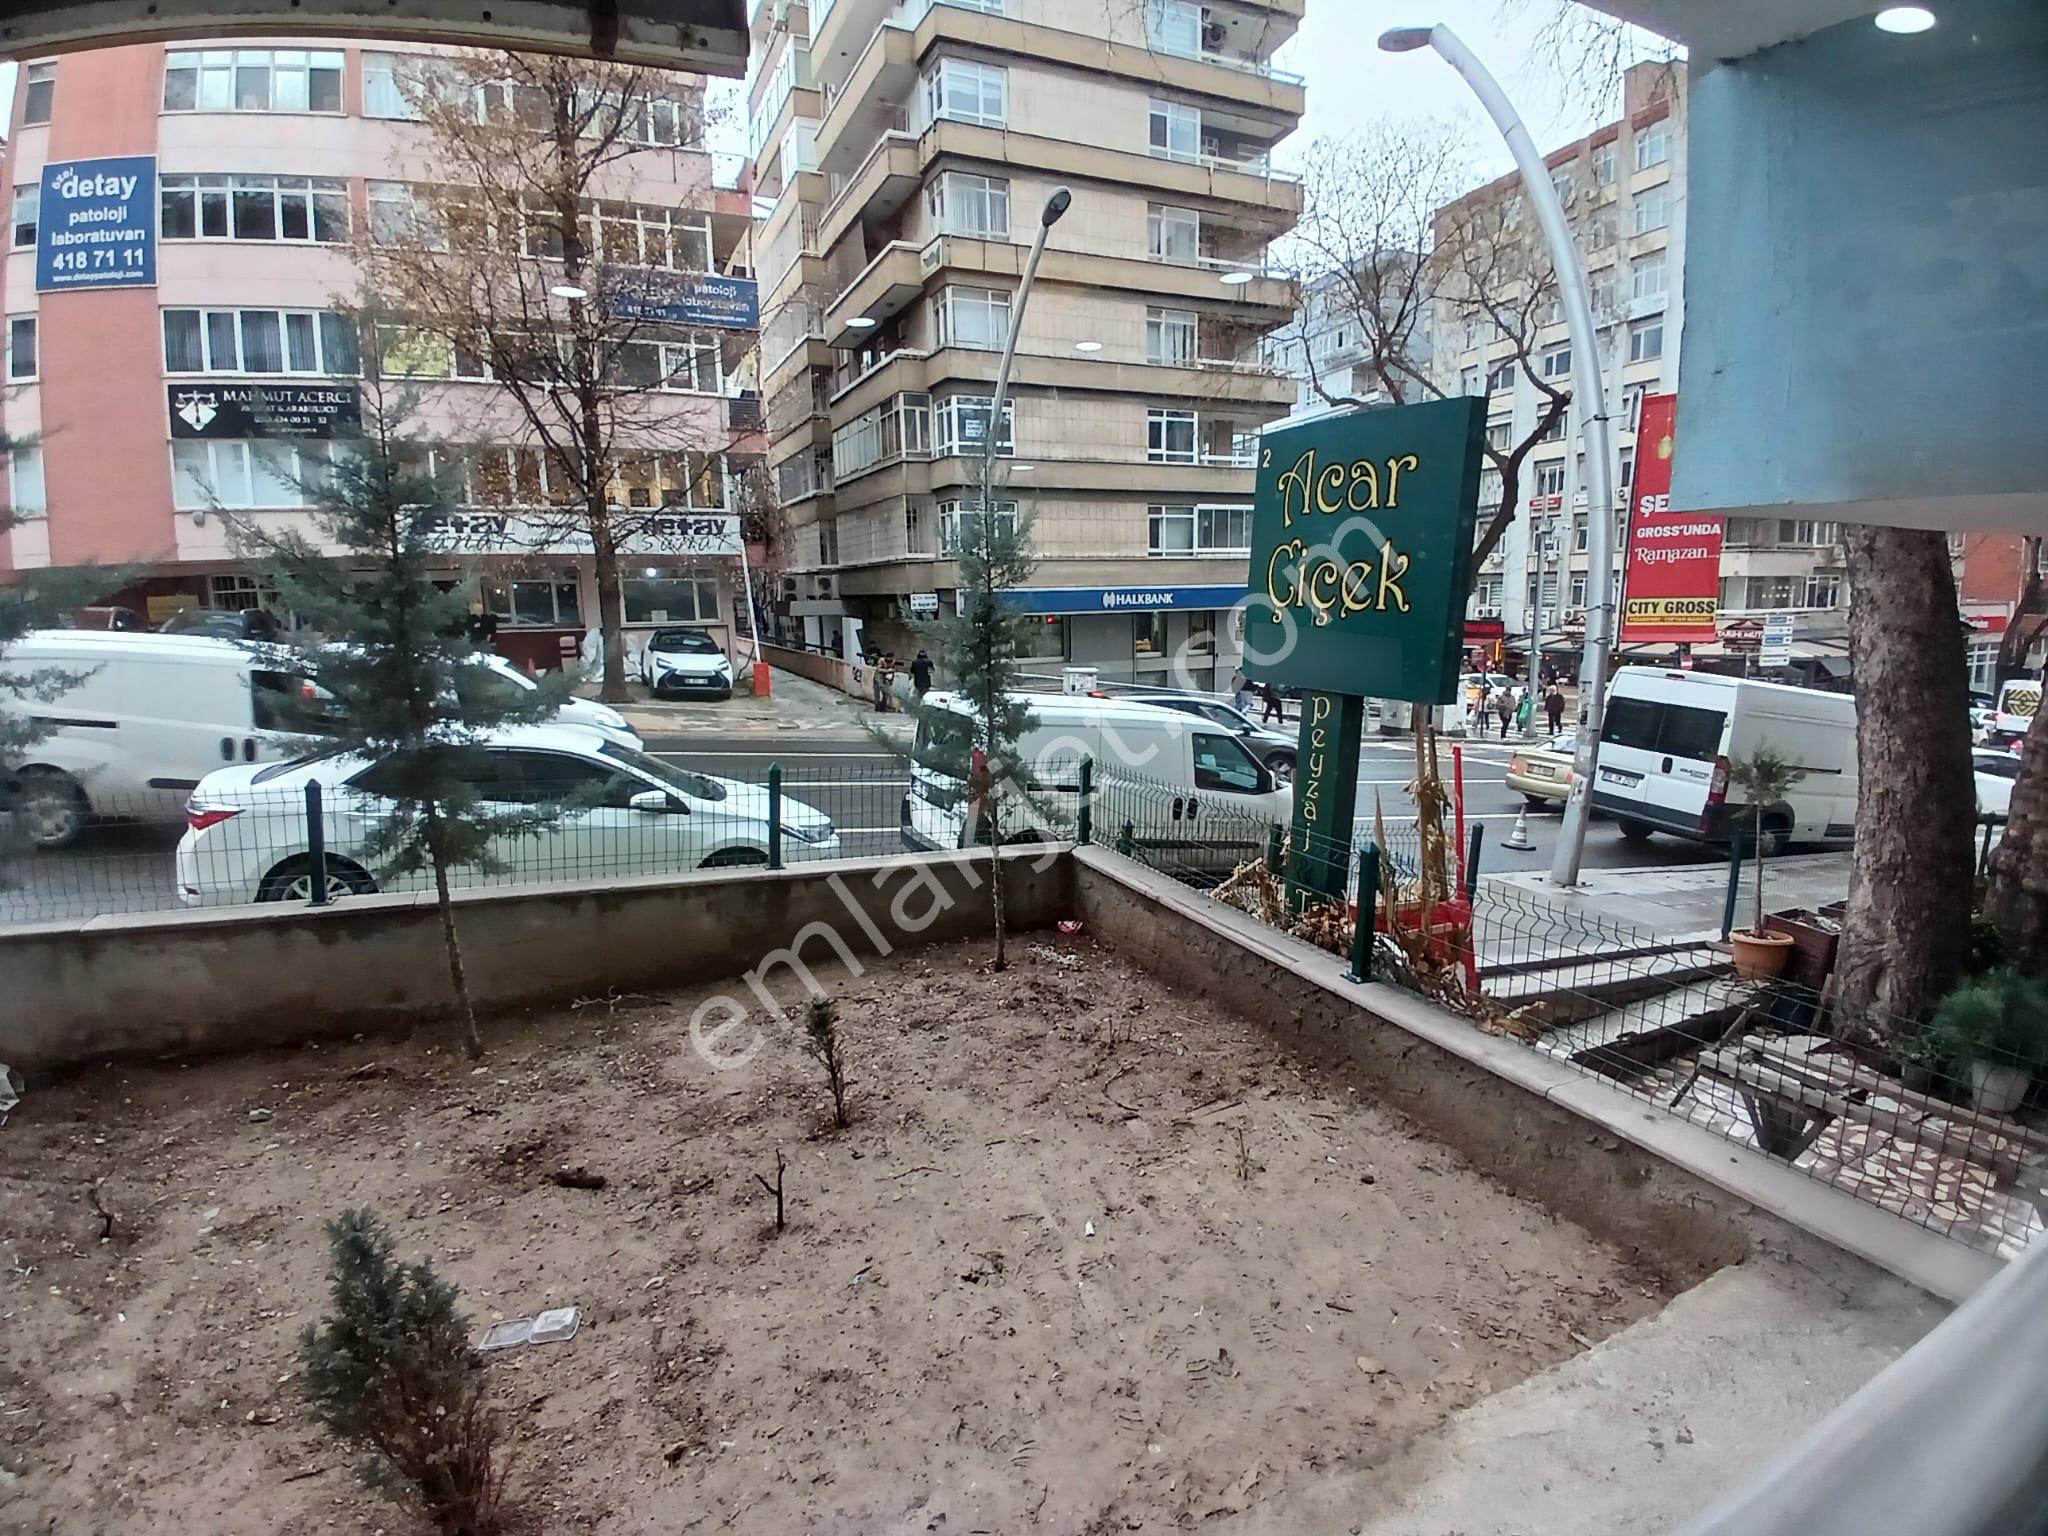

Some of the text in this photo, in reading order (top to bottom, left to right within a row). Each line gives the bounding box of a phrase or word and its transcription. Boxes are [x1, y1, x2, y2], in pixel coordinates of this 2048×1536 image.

[61, 173, 138, 200] detay
[68, 205, 128, 227] patoloji
[51, 229, 145, 246] laboratuvarı
[52, 247, 144, 270] 418 71 11
[694, 284, 738, 298] patoloji
[1262, 448, 1271, 468] 2
[1278, 449, 1419, 528] Acar
[1267, 539, 1411, 627] Çiçek
[1115, 592, 1174, 606] HALKBANK
[1628, 600, 1716, 615] CITY GROSS
